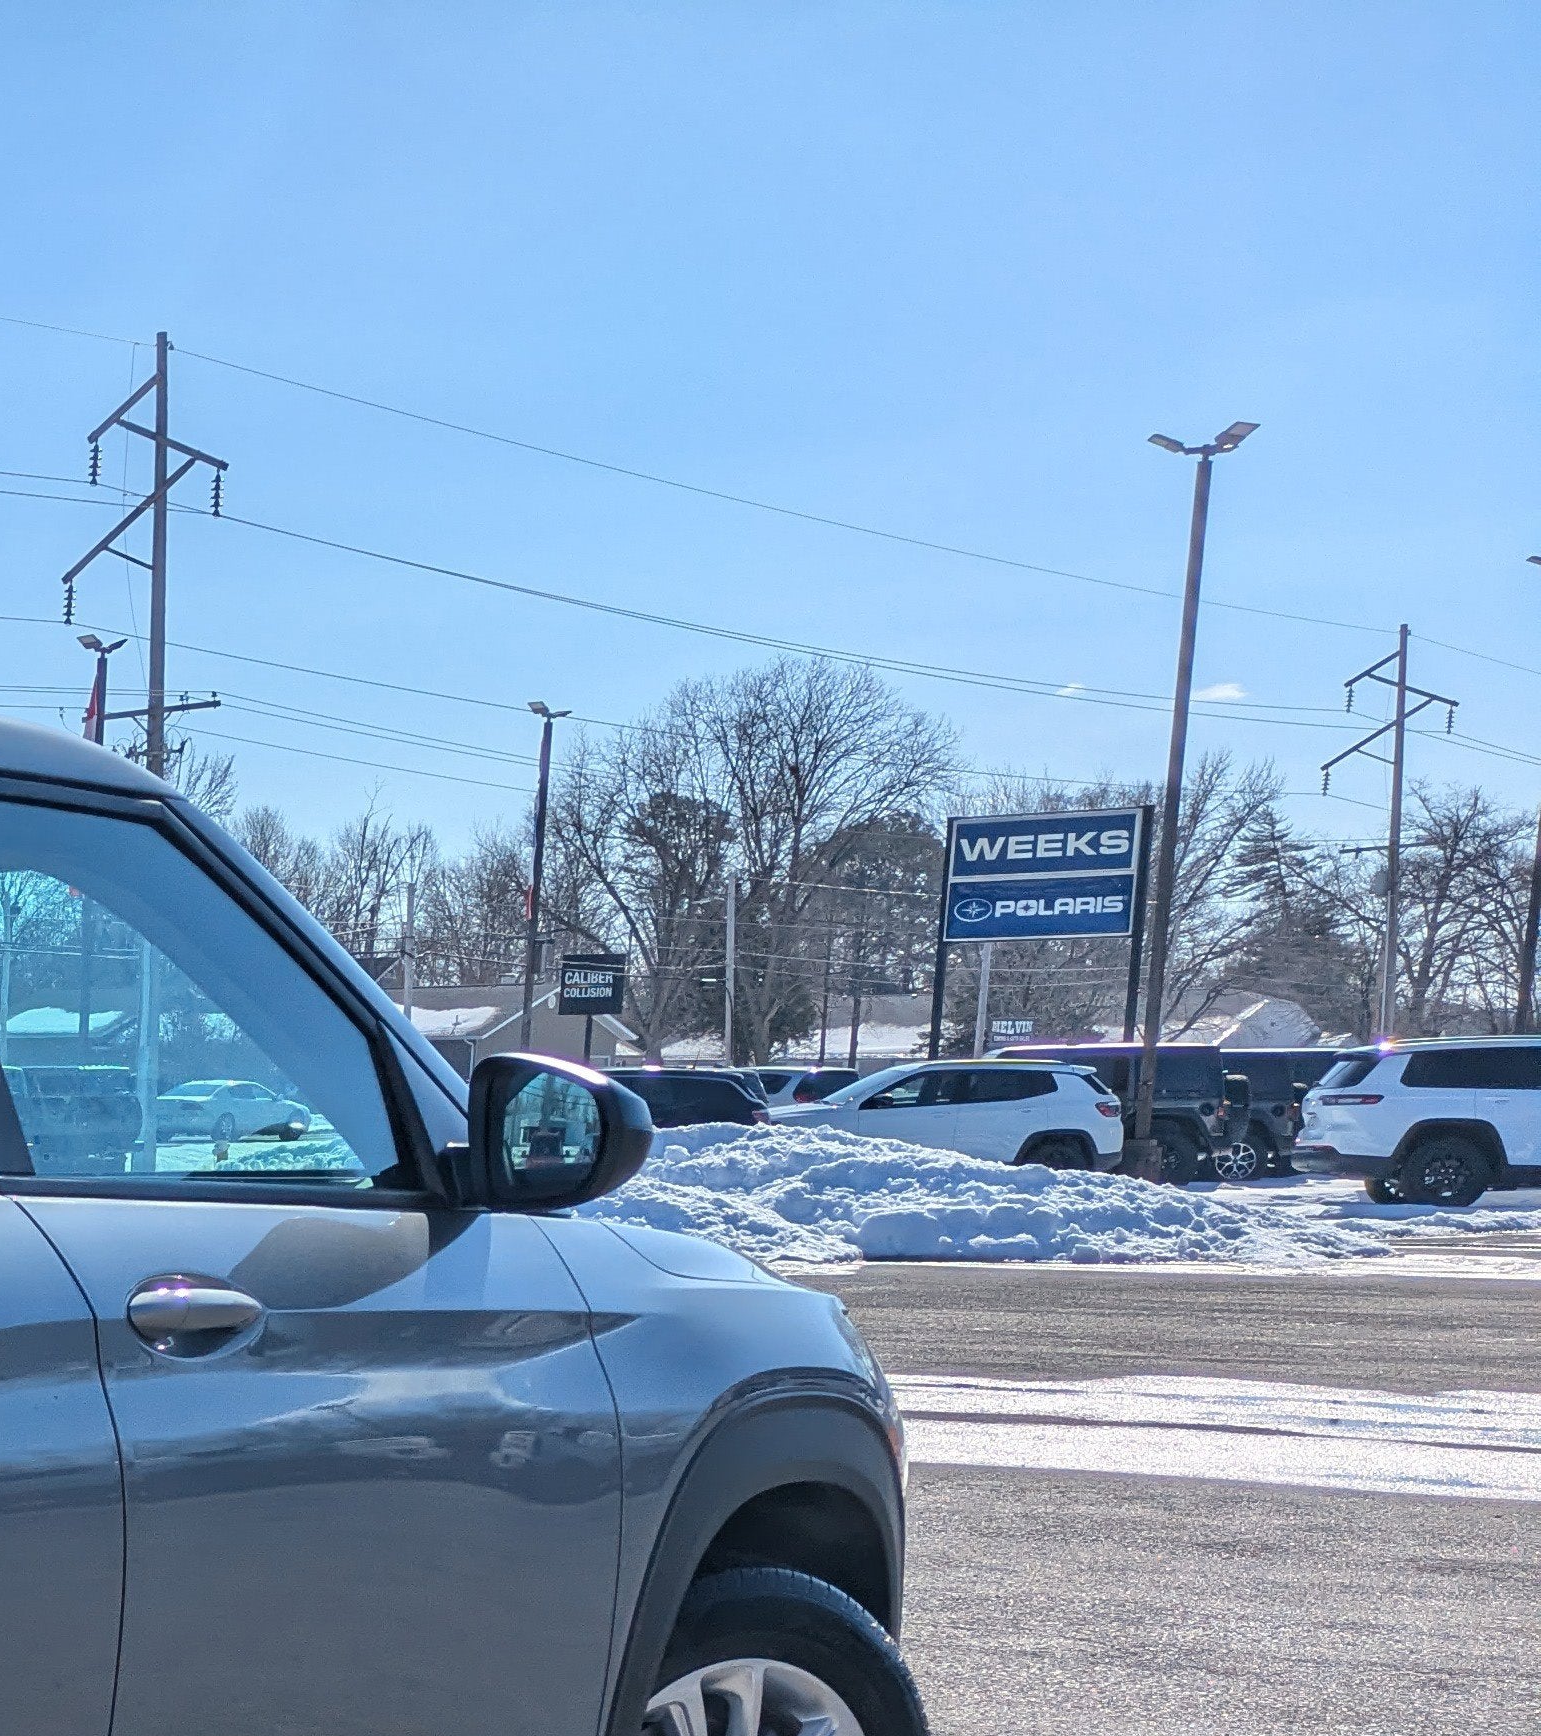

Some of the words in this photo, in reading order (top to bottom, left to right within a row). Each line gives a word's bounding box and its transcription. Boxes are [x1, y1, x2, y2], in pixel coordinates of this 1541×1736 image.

[959, 829, 1130, 862] WEEKS
[994, 895, 1124, 918] POLARIS
[564, 971, 614, 985] CALIBER
[563, 986, 613, 998] COLLISION
